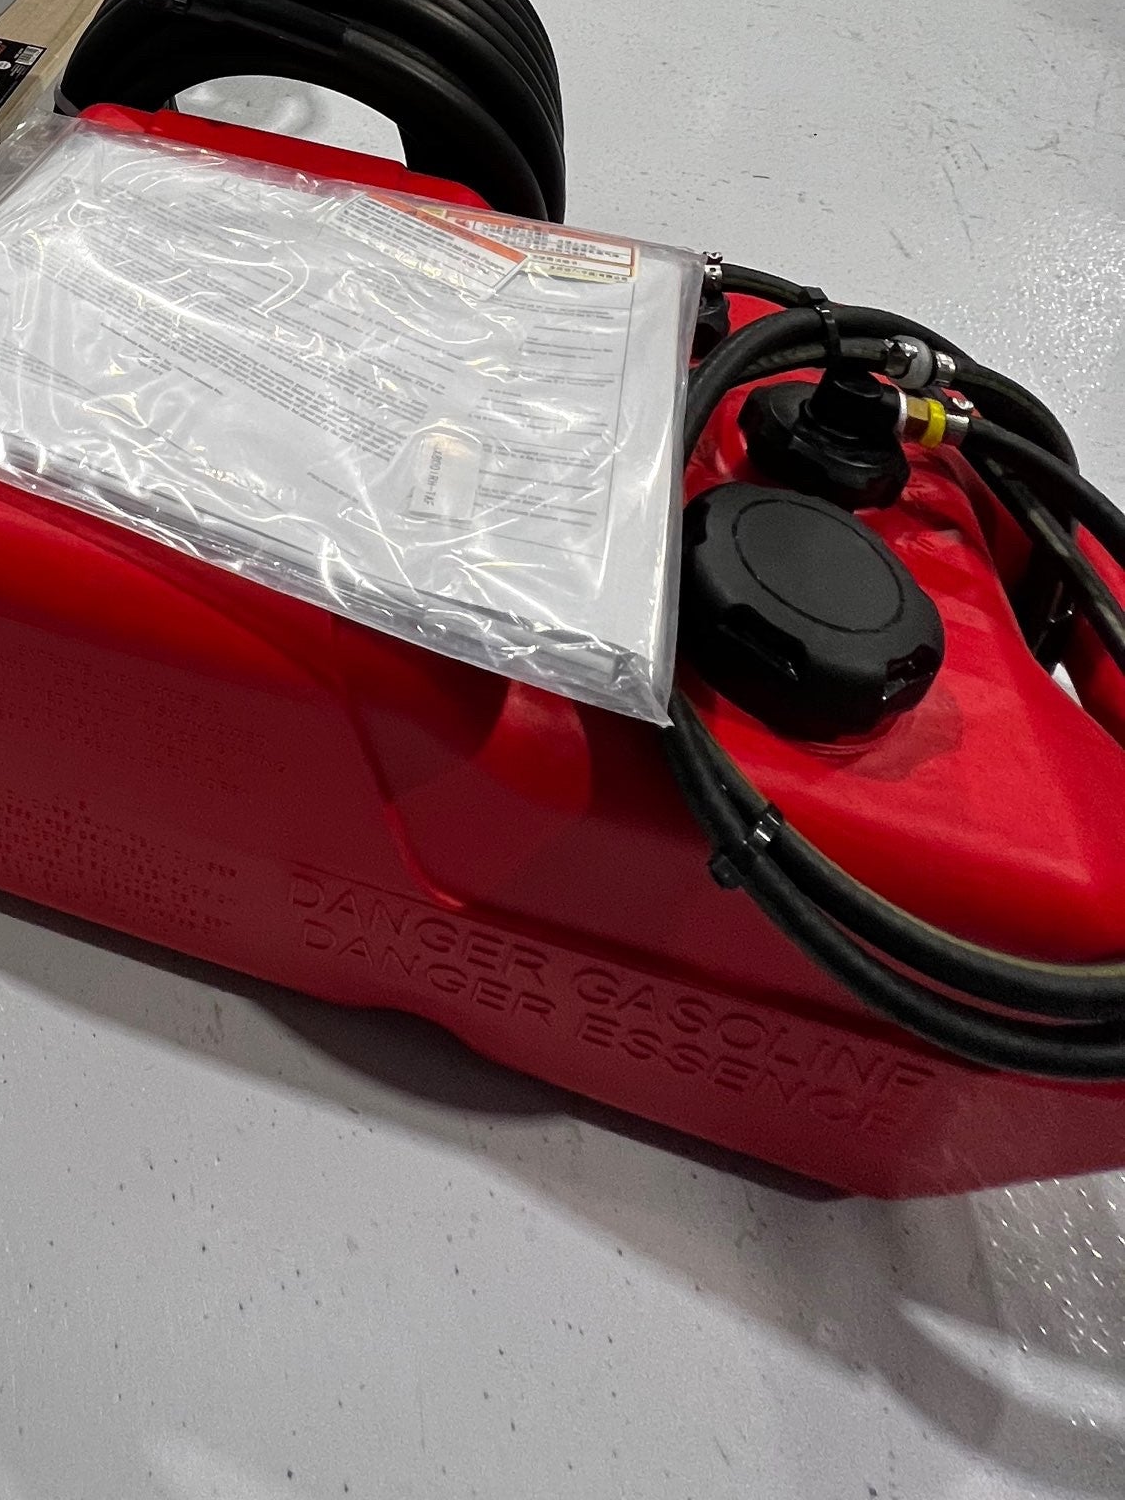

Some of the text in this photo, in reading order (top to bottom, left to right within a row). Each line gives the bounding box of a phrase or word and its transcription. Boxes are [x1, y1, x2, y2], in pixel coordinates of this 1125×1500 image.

[289, 871, 550, 986] DANGER
[301, 918, 895, 1130] DANGER ESSENCE
